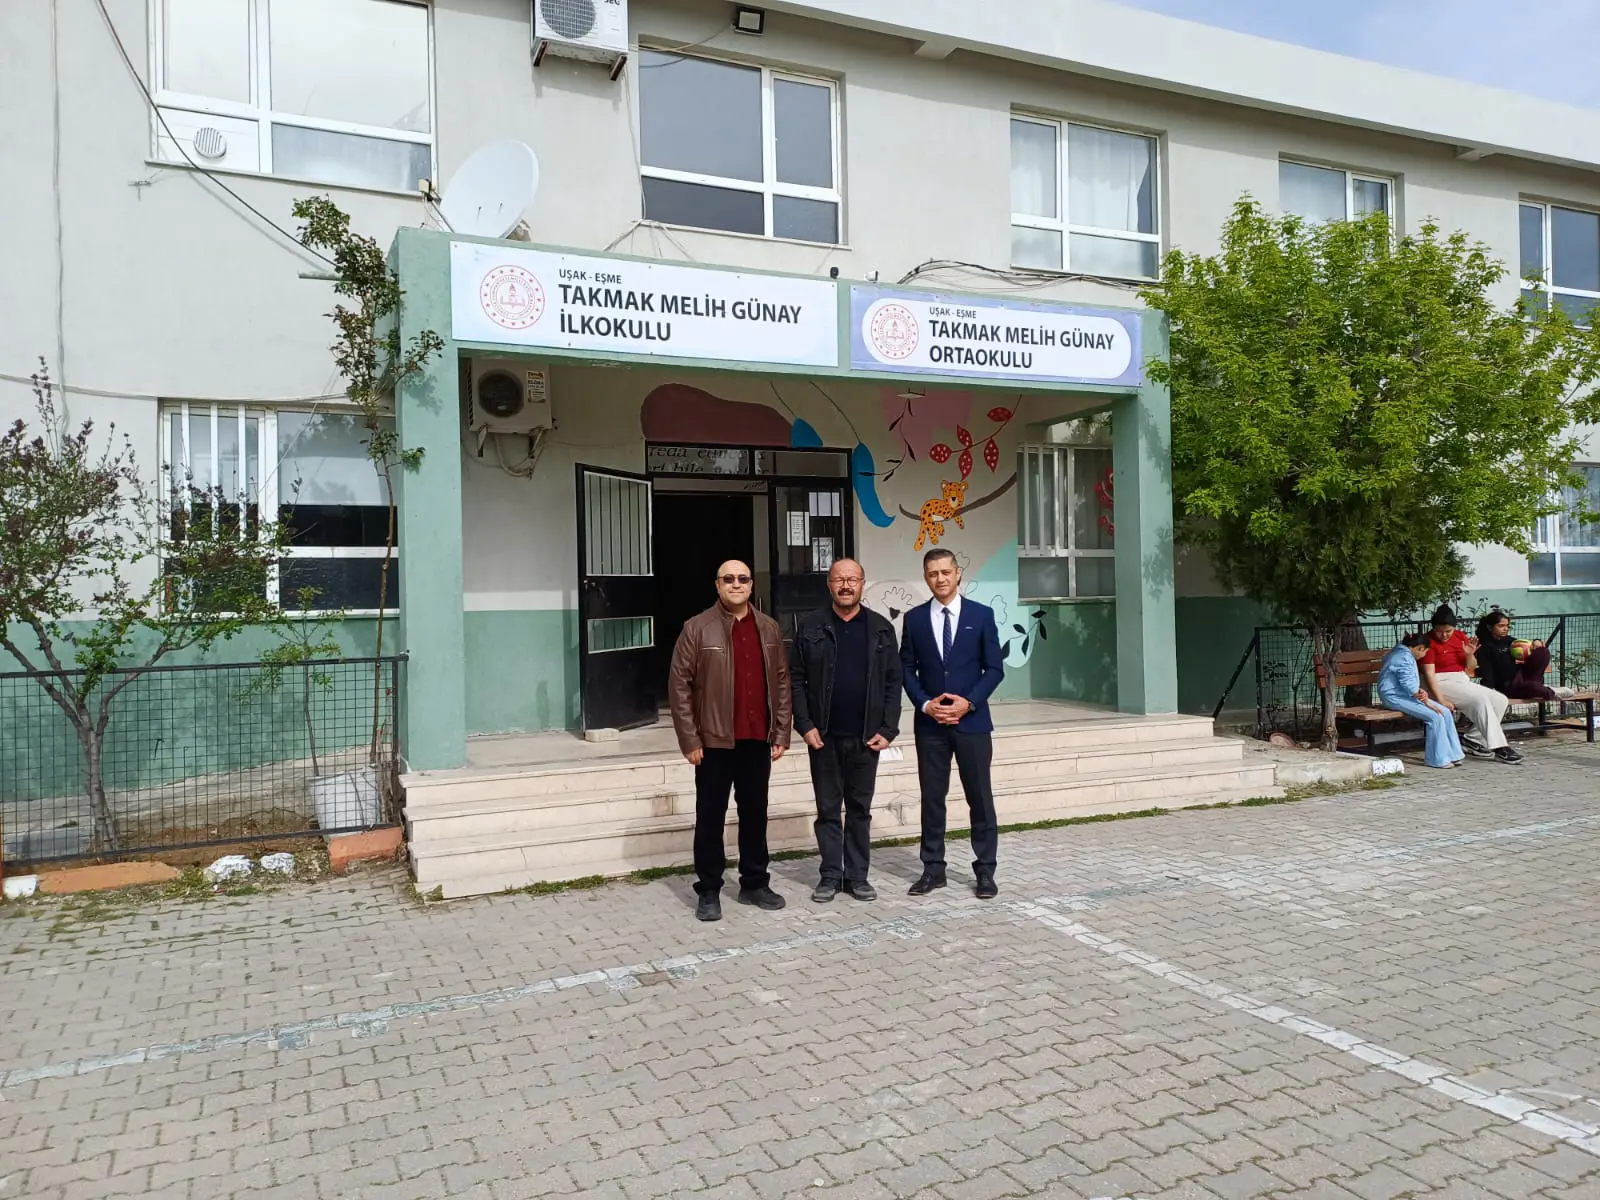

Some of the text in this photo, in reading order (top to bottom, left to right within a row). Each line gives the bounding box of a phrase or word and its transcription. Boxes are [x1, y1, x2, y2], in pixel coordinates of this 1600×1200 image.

[559, 268, 587, 281] UŞAK
[595, 272, 622, 285] EŞME
[558, 284, 655, 312] TAKMAK
[660, 293, 726, 318] MELİH
[731, 298, 802, 324] GÜNAY
[929, 306, 951, 317] UŞAK
[956, 309, 977, 320] EŞME
[560, 308, 671, 342] İLKOKULU
[929, 319, 1001, 342] TAKMAK
[1005, 325, 1056, 346] MELİH
[1060, 327, 1115, 350] GÜNAY
[929, 345, 1032, 368] ORTAOKULU
